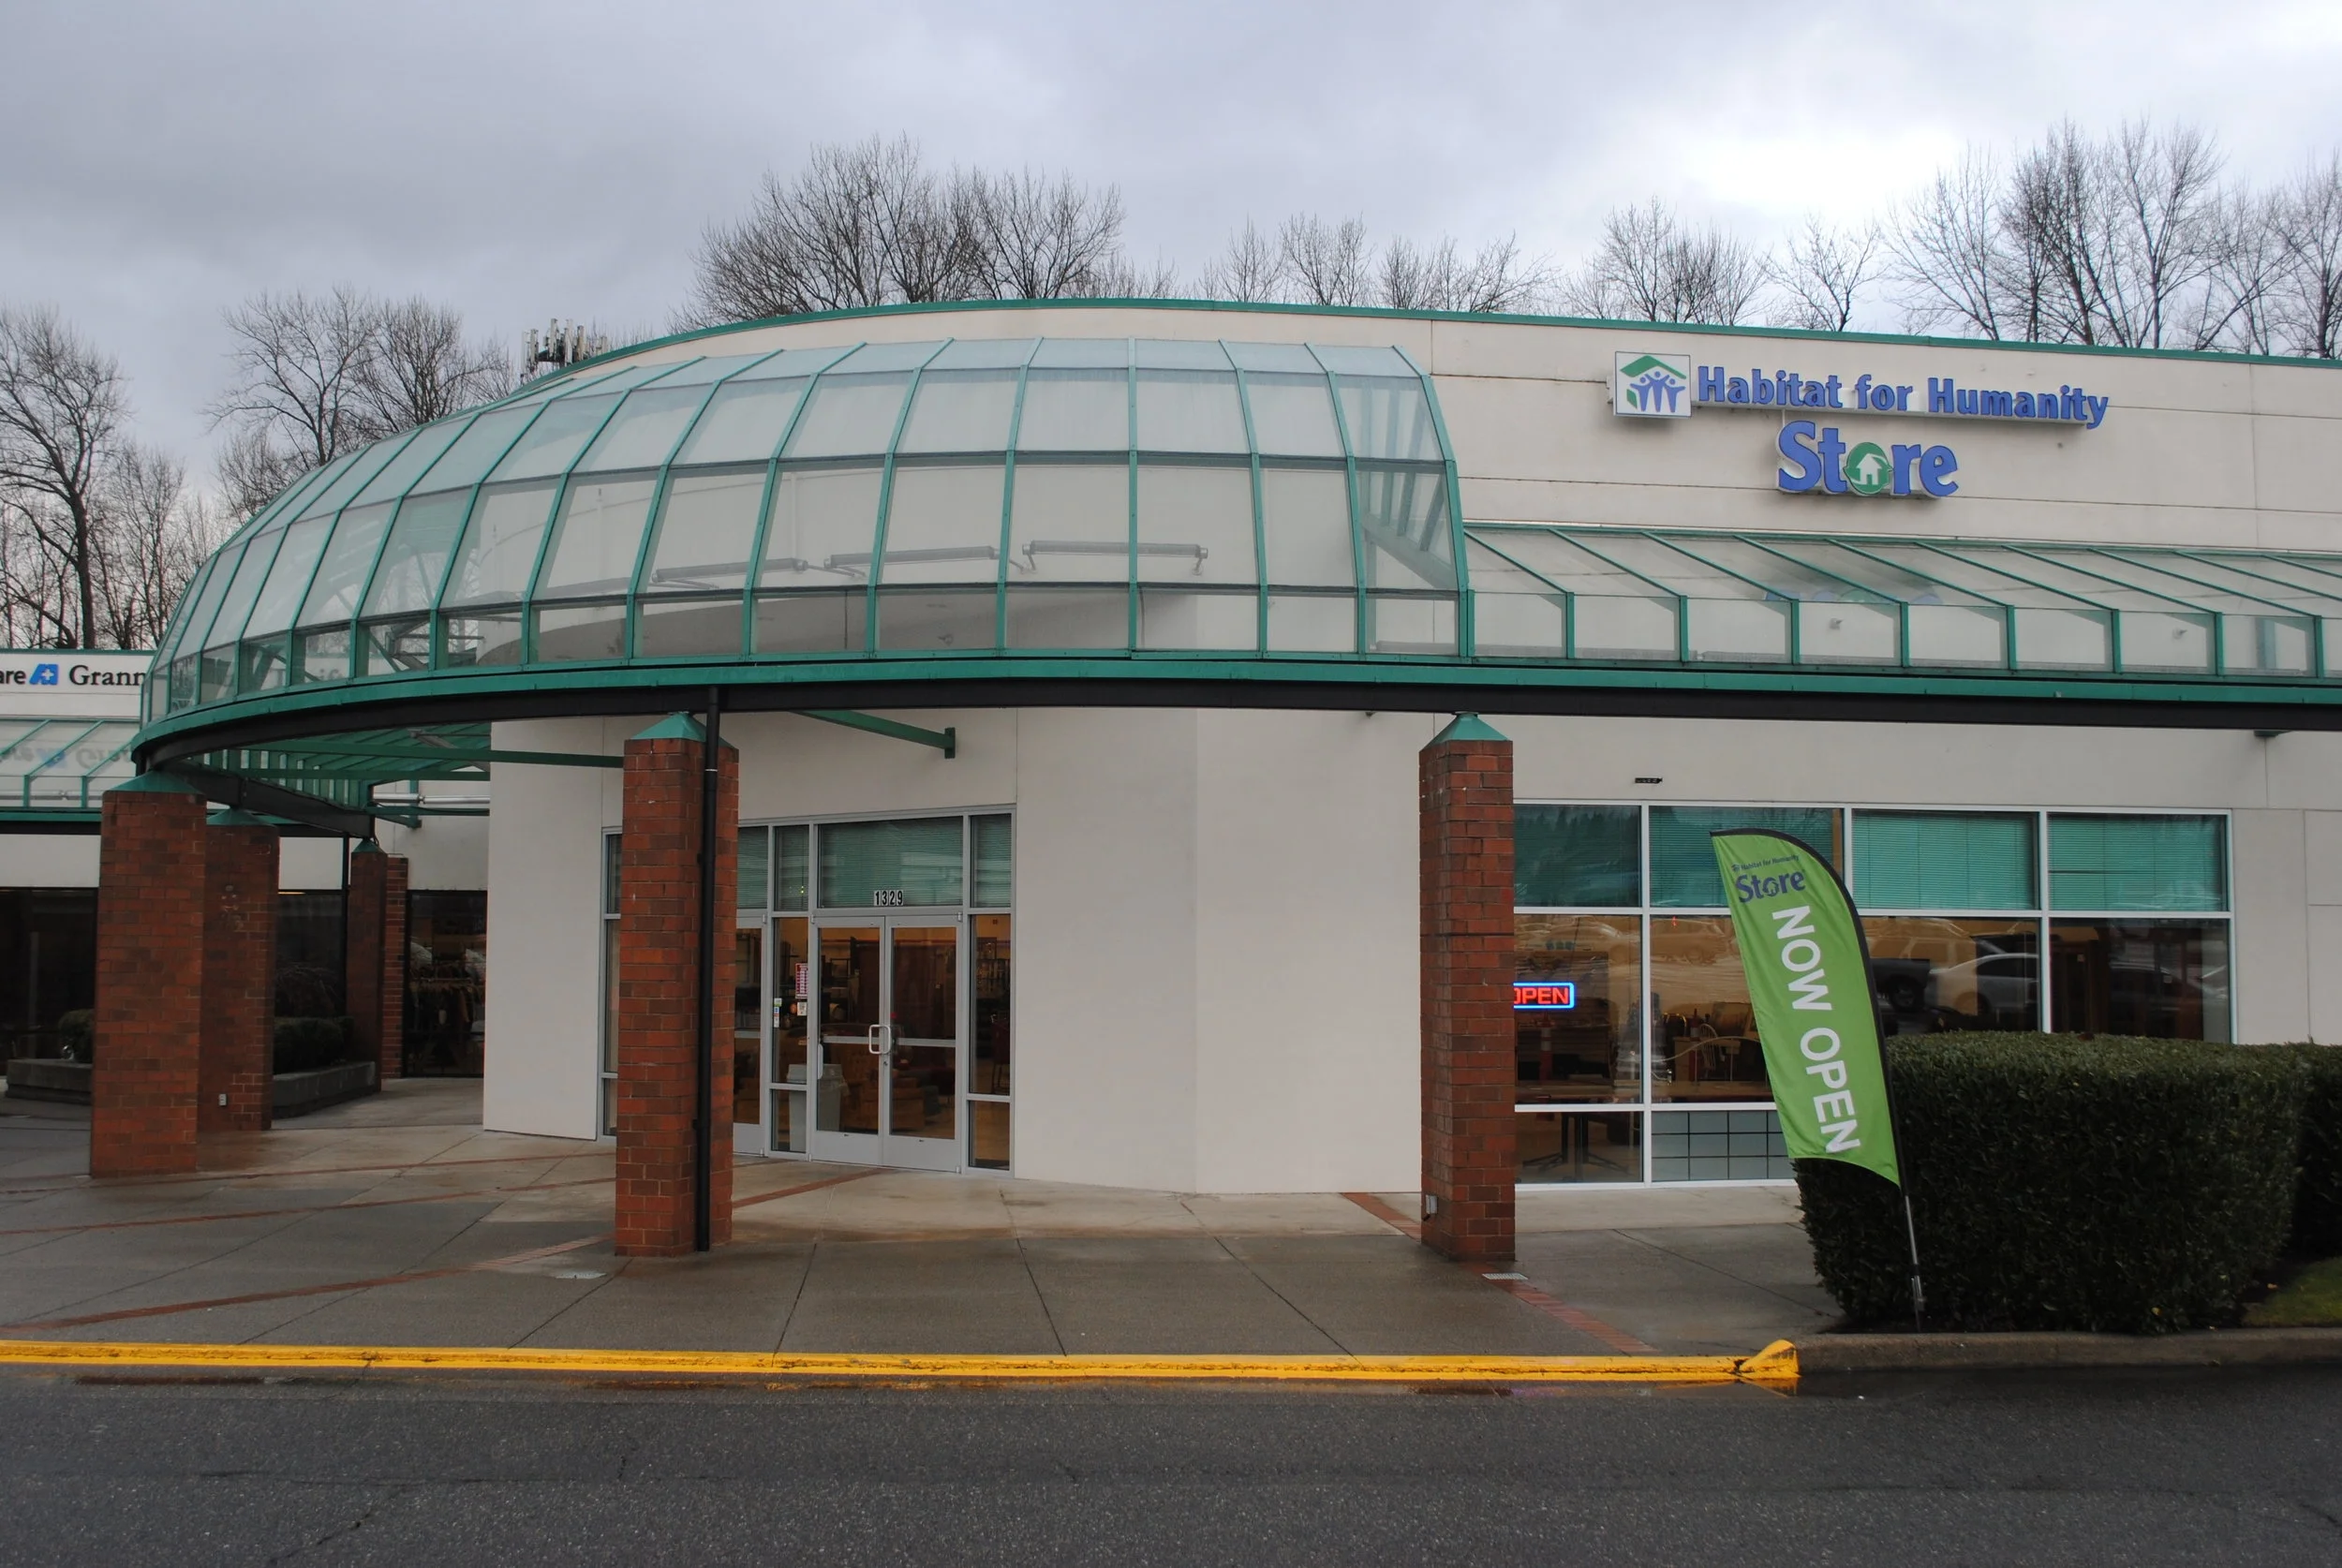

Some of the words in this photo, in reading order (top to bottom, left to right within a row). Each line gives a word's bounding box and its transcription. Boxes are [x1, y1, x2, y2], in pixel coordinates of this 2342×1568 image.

[1697, 365, 1844, 408] Habitat
[1854, 374, 1914, 411] for
[1927, 377, 2109, 430] Humanity
[1777, 420, 1959, 497] Store
[875, 890, 903, 906] 1329
[1735, 870, 1806, 903] Store
[1771, 905, 1832, 1011] NOW
[1800, 1027, 1861, 1154] OPEN
